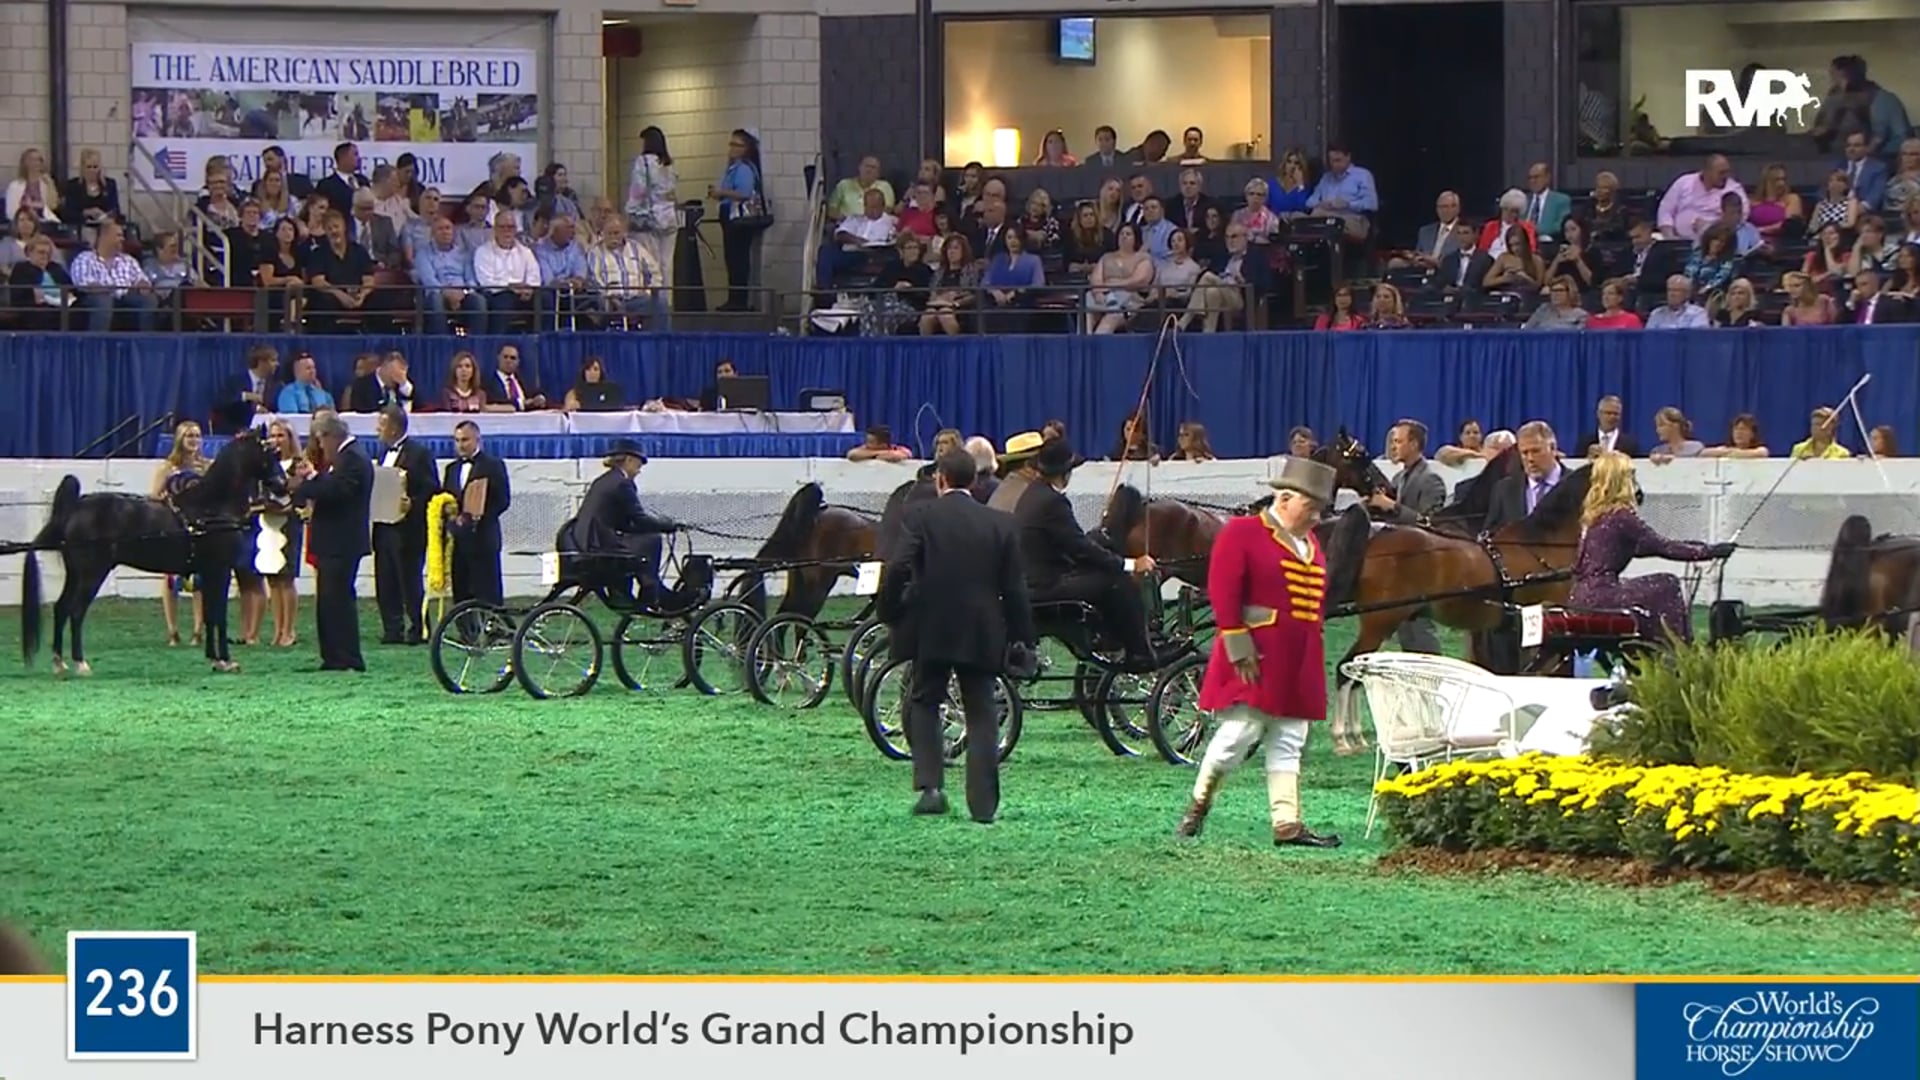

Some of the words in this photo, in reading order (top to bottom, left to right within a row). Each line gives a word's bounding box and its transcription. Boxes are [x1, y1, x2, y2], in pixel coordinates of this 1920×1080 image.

[150, 54, 200, 81] THE
[209, 56, 341, 85] AMERICAN
[349, 58, 520, 87] SADDLEBRED
